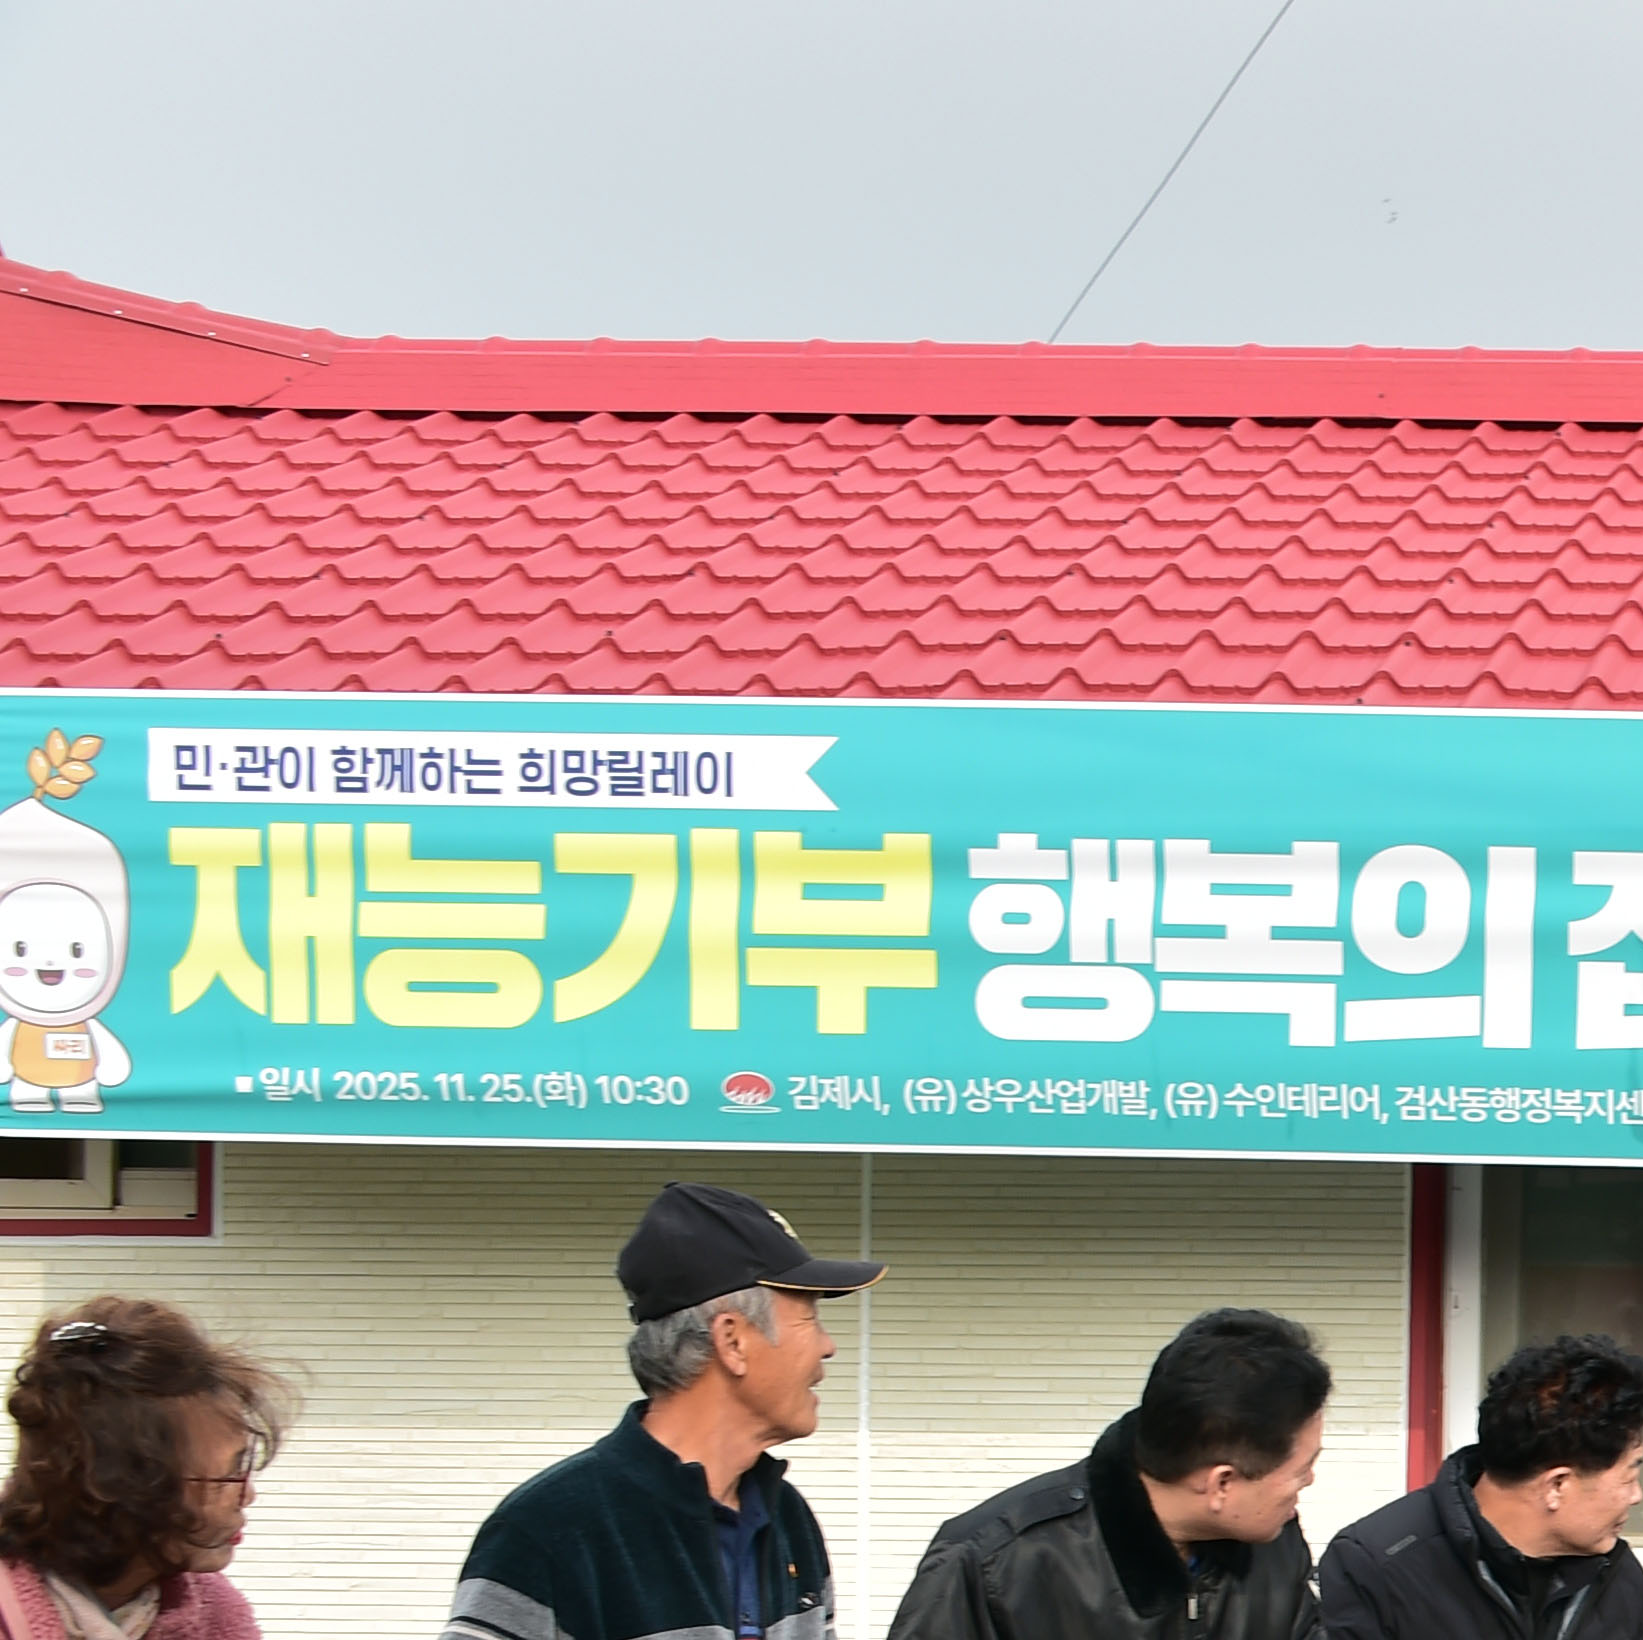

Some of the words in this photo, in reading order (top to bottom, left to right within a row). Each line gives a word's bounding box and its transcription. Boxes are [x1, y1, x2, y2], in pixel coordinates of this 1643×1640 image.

[176, 744, 317, 793] 민·관이
[331, 746, 504, 796] 함께하는
[519, 748, 734, 799] 희망릴레이
[169, 822, 938, 1036] 재능기부
[258, 1066, 323, 1102] 일시
[595, 1076, 691, 1106] 10:30
[788, 1075, 891, 1117] 김제시,
